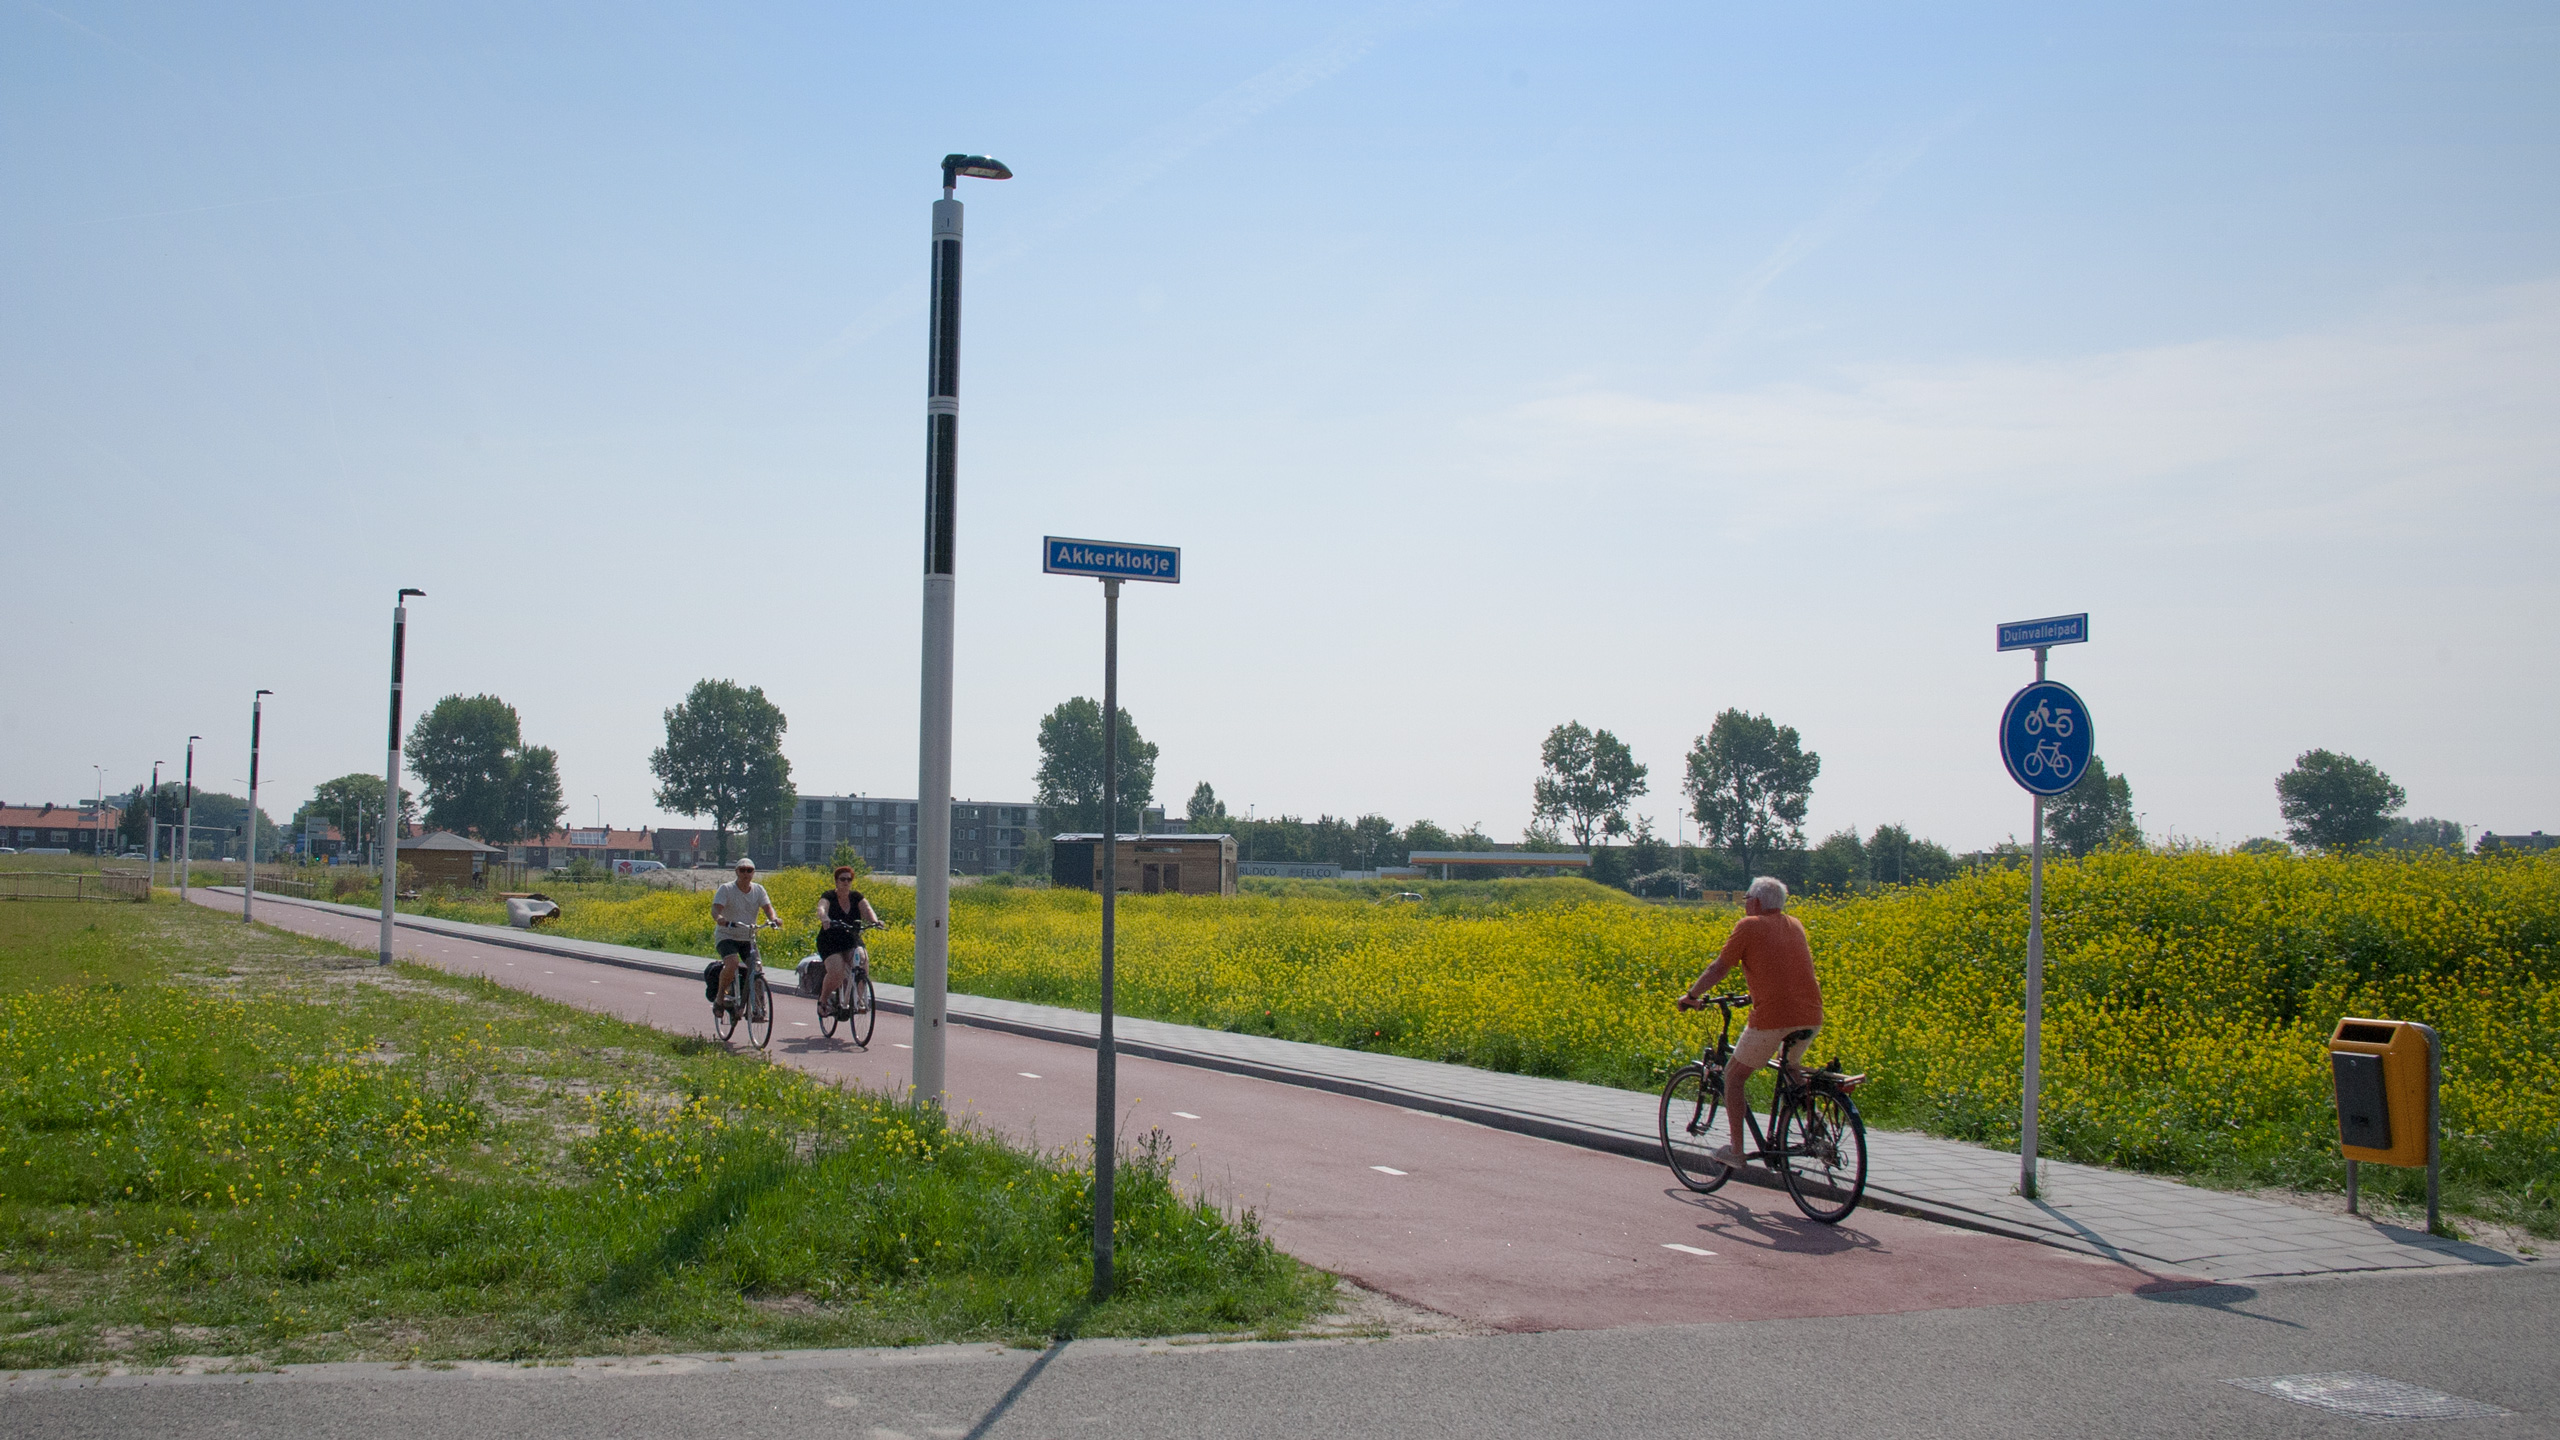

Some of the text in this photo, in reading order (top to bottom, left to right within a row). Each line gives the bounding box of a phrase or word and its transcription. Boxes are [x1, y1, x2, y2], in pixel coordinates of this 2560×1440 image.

[1057, 546, 1169, 575] Akkerklokje
[2004, 621, 2077, 642] Duinvalleipad
[1300, 868, 1331, 878] FELCO
